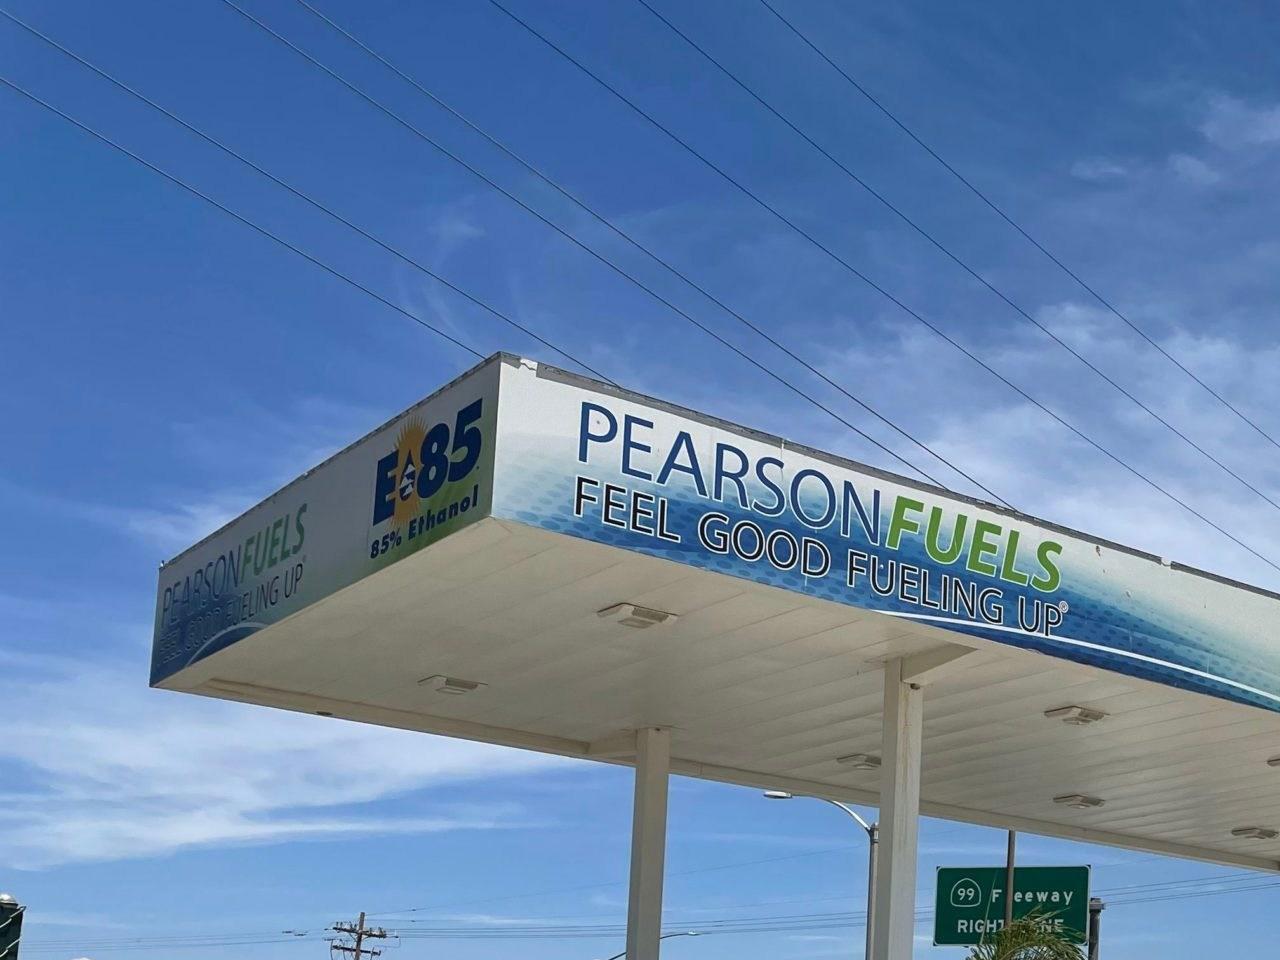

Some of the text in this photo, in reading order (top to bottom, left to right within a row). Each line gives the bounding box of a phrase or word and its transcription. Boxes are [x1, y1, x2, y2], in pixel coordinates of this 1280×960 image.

[370, 484, 479, 559] 85% Ethanol
[574, 475, 681, 543] FEEL
[698, 511, 831, 578] GOOD
[847, 548, 1004, 625] FUELING
[957, 888, 1074, 905] 99 Feeway
